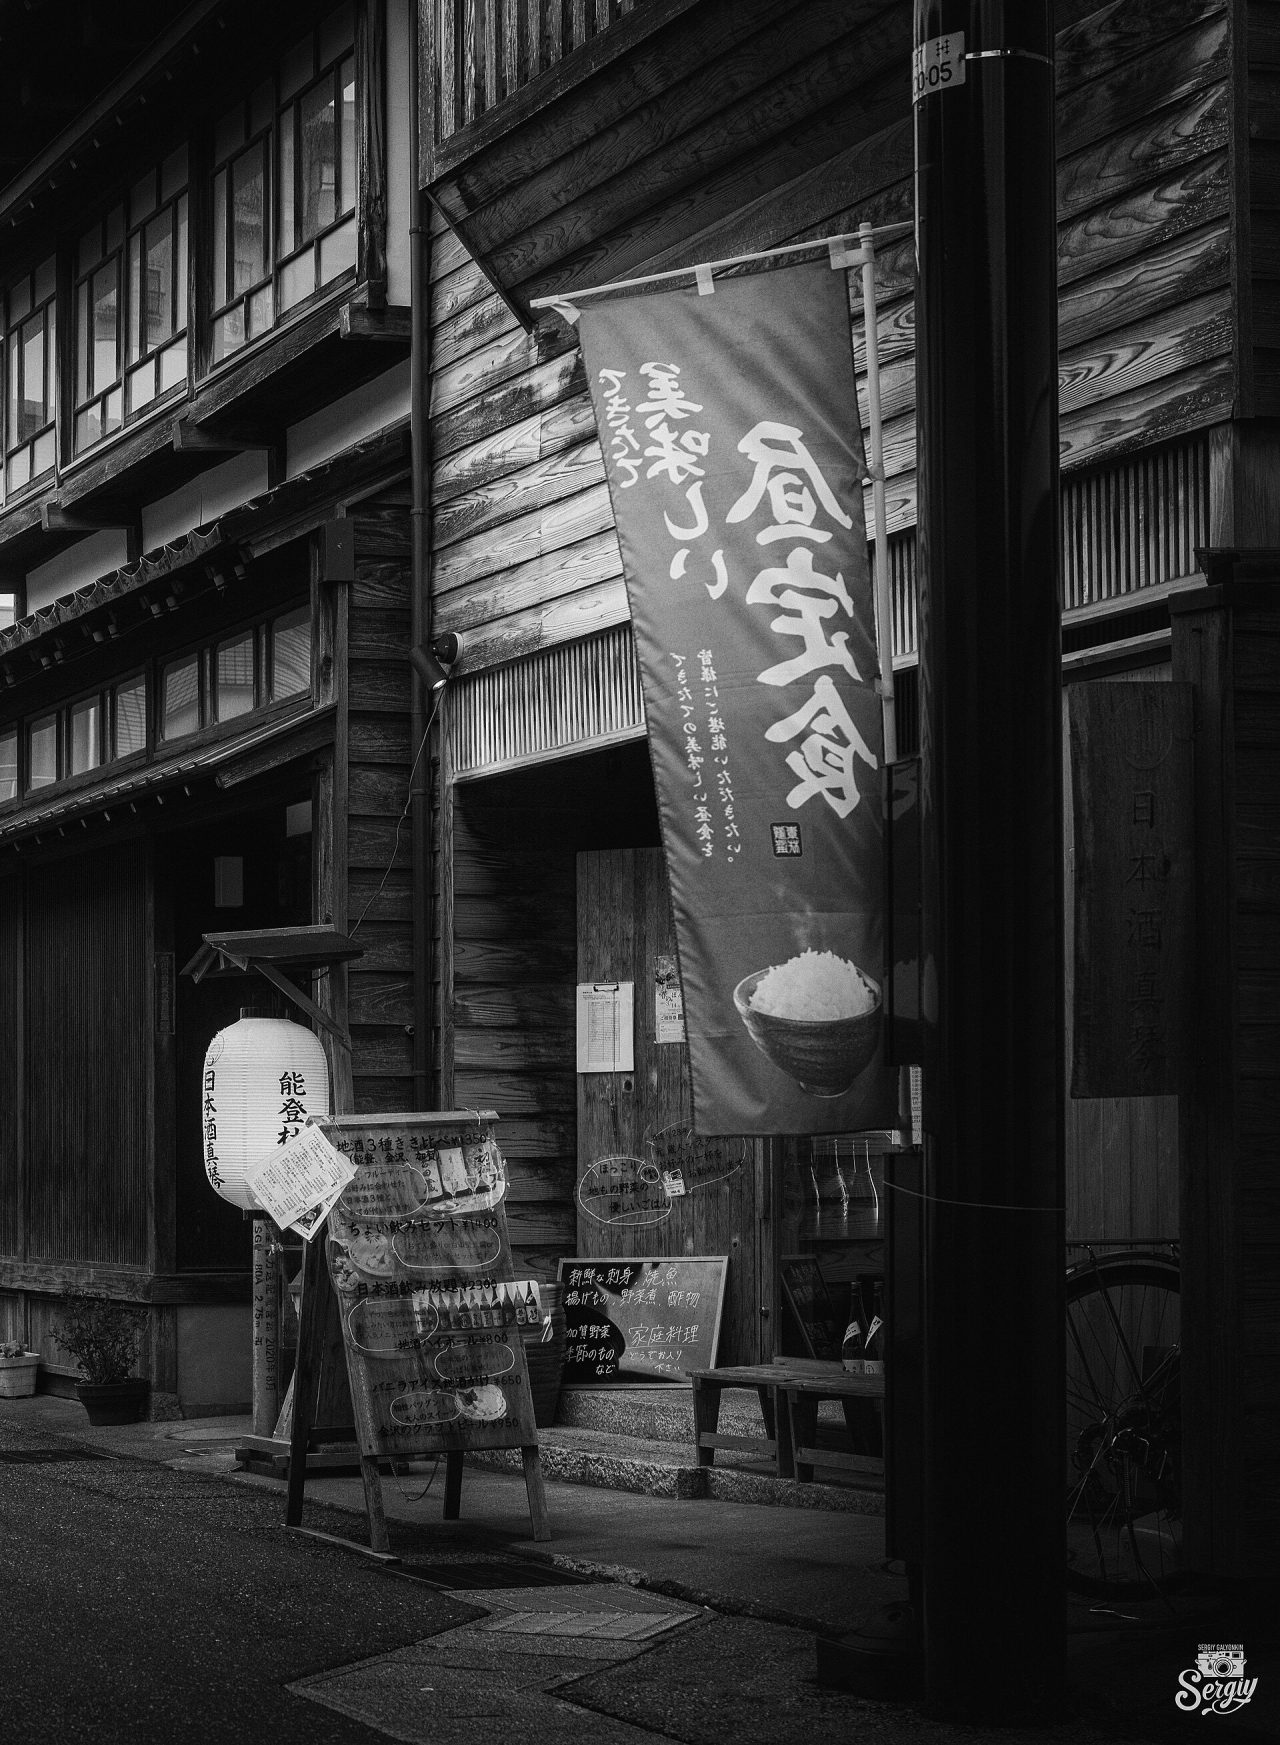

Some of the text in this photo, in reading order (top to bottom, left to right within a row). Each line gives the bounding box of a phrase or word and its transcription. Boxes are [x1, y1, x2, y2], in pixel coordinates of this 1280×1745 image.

[565, 1324, 611, 1340] 加賀野菜
[627, 1323, 700, 1348] 家庭料理
[564, 1344, 616, 1362] 季節のもの
[595, 1363, 617, 1376] など
